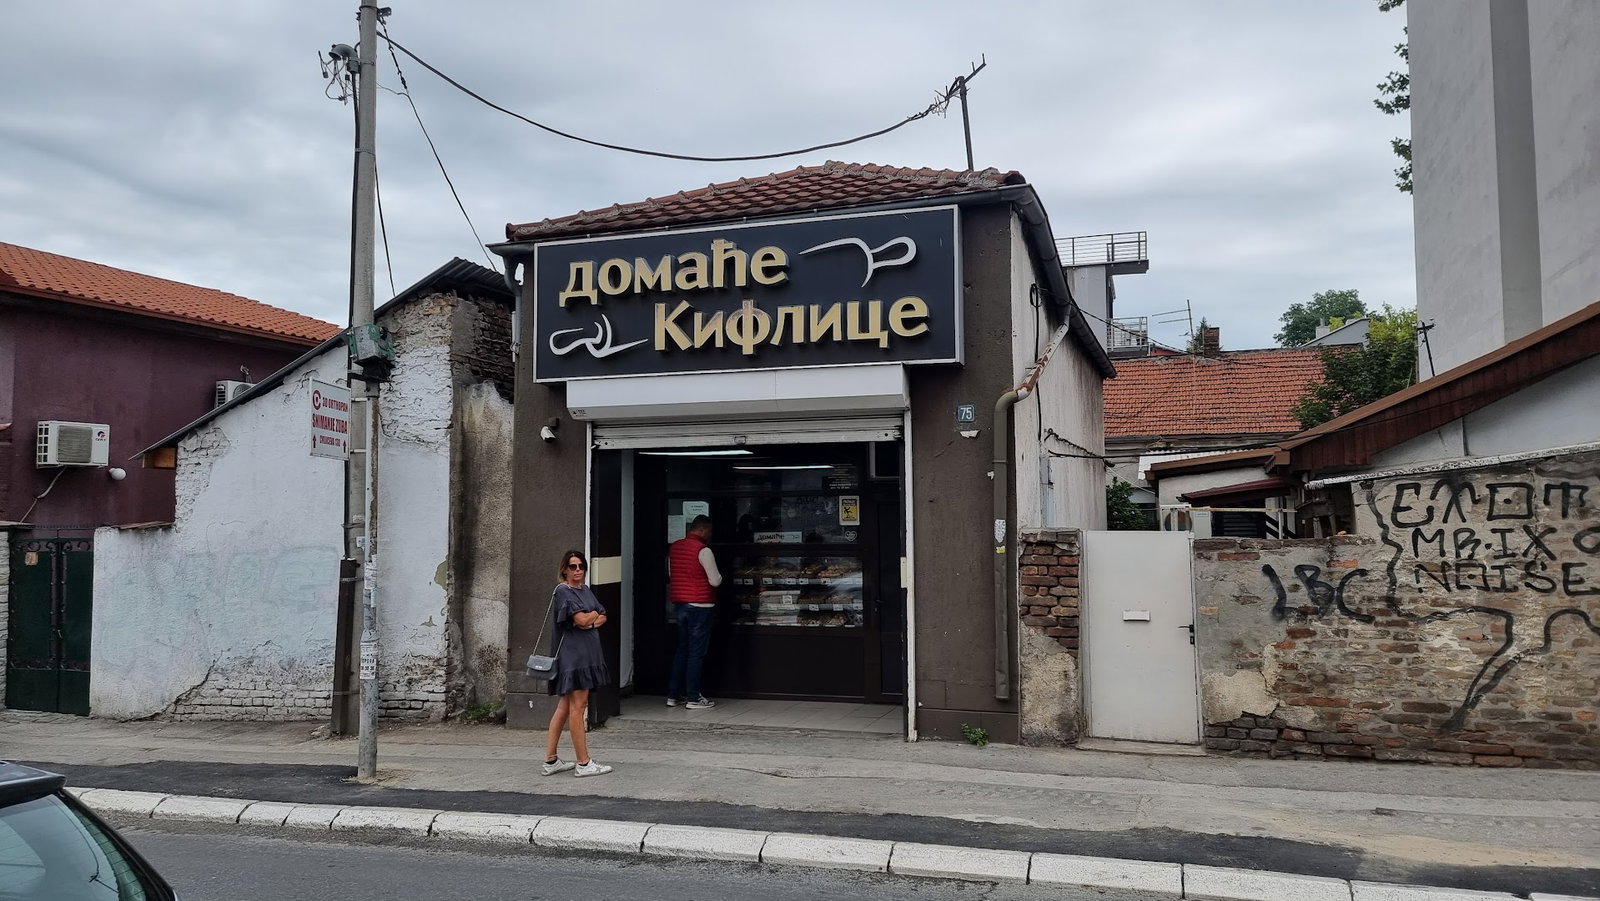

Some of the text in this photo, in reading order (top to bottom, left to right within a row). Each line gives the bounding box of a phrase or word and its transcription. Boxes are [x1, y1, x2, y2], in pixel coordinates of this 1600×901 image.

[558, 239, 789, 307] домаће
[654, 296, 929, 355] Кифлице
[312, 413, 348, 434] SNIMANJE ZUBA
[960, 407, 972, 419] 75
[1414, 560, 1600, 597] NOISE
